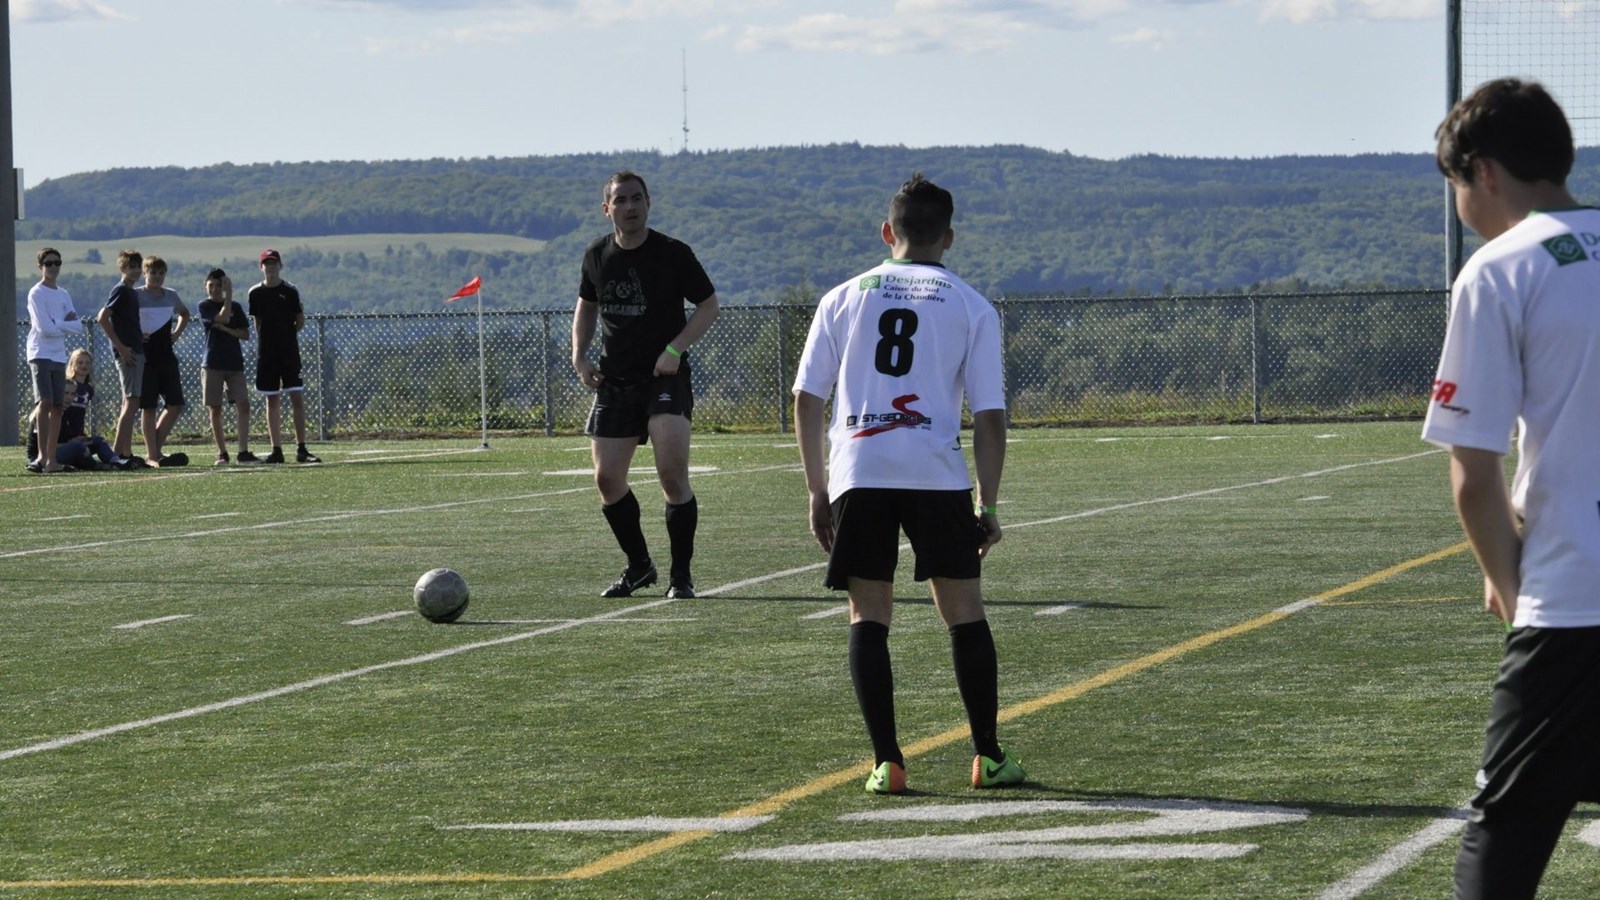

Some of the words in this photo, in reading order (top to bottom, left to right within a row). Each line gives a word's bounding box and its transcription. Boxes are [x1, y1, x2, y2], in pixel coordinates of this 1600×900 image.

[884, 284, 910, 292] Caisse
[885, 274, 953, 289] Desjardins
[904, 293, 946, 304] Chaudière
[874, 308, 918, 377] 8
